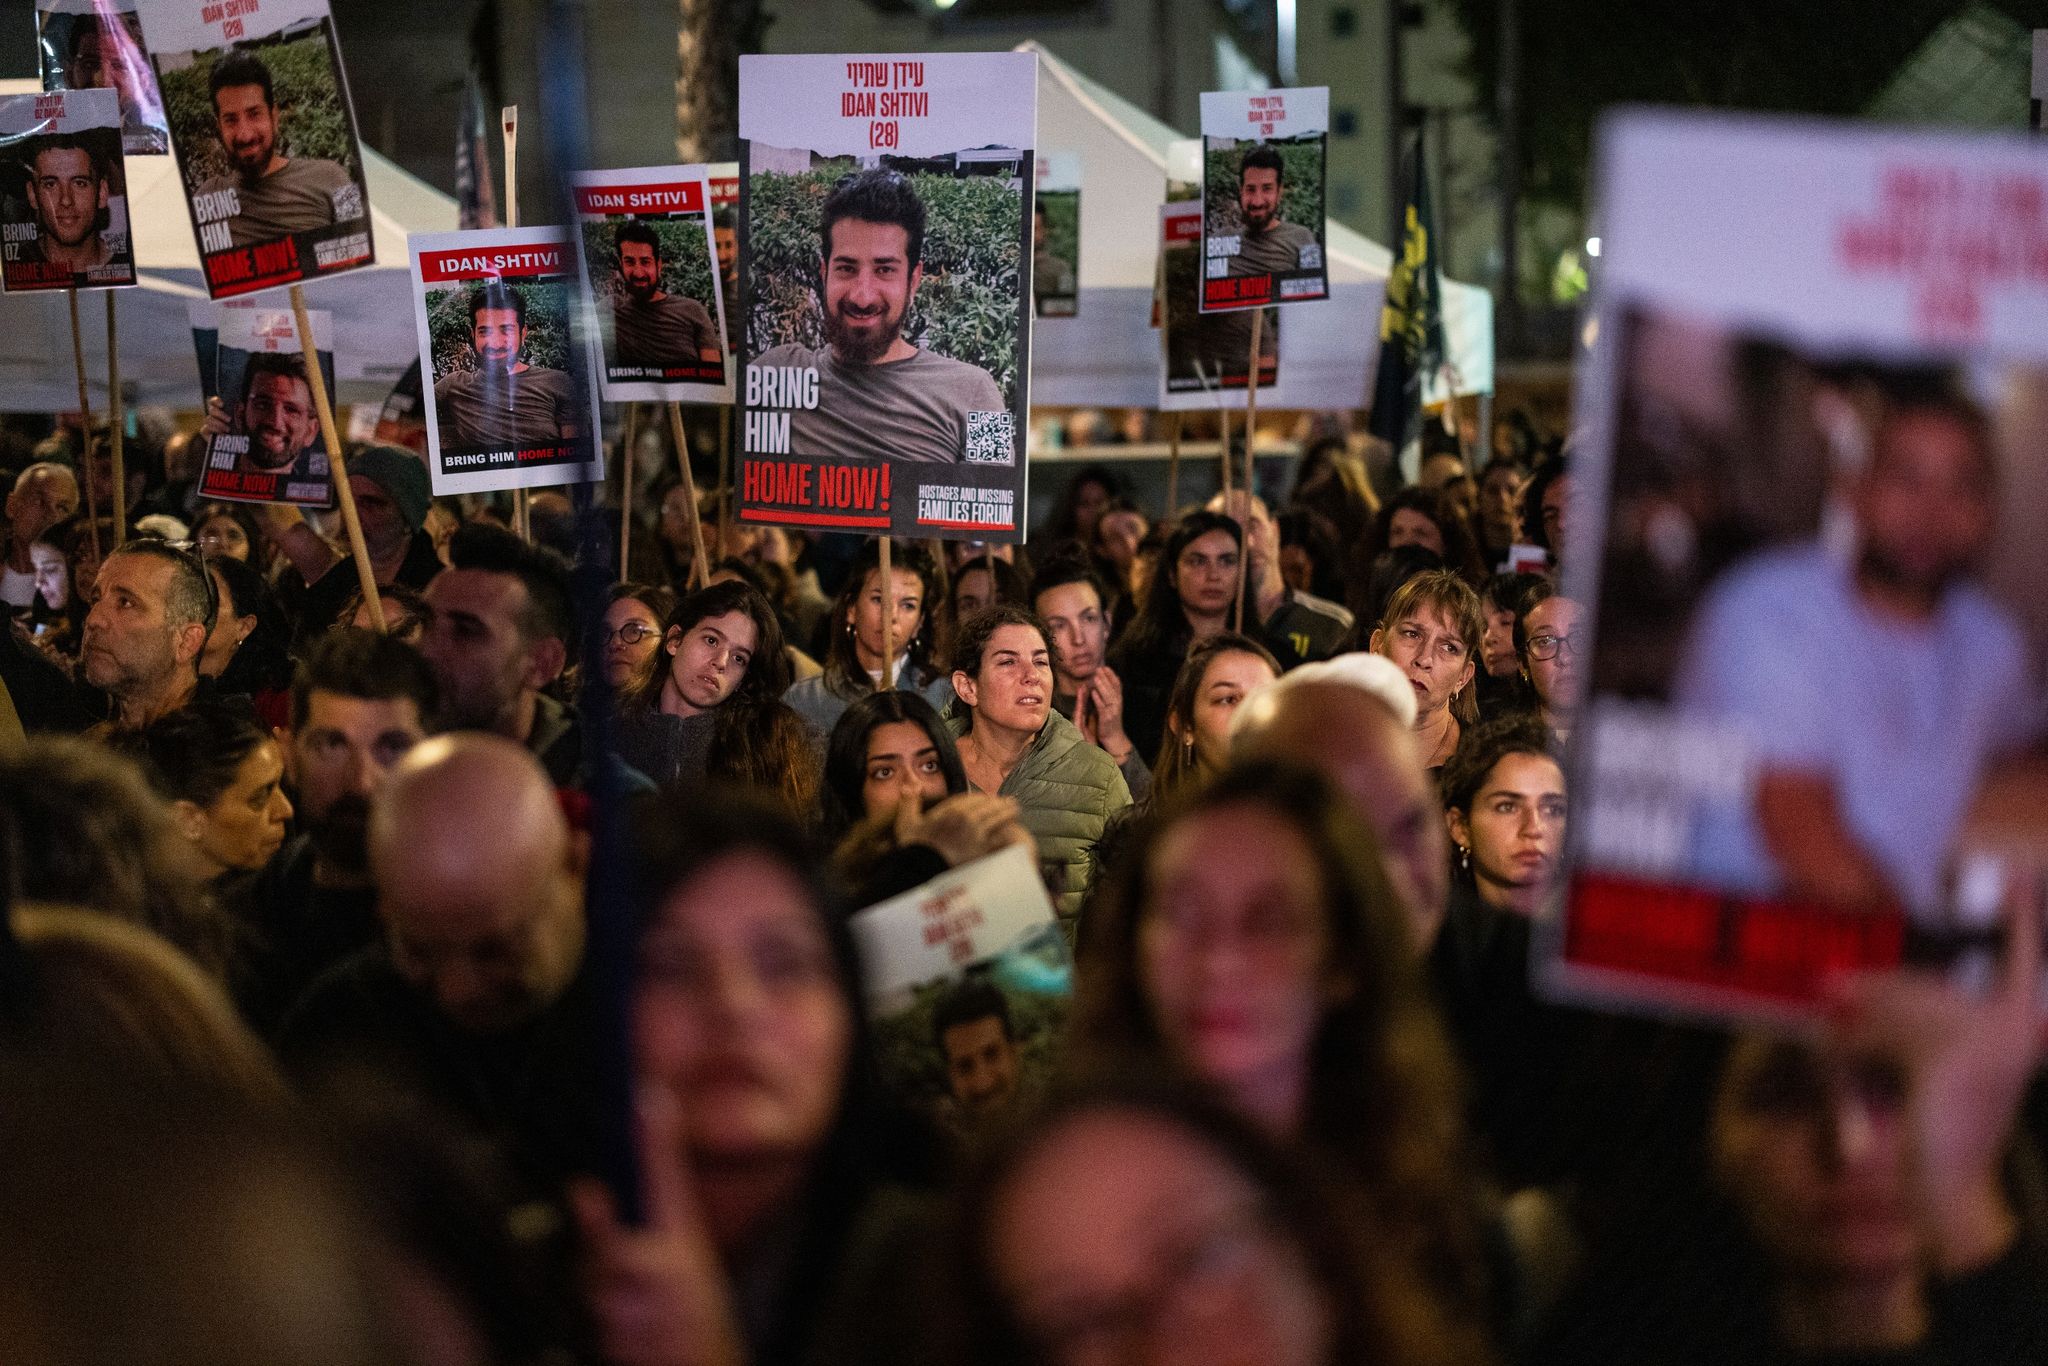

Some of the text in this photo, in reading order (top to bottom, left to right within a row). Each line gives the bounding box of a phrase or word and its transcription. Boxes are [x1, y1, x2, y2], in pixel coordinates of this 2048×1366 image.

[202, 4, 225, 24] IDAN
[223, 18, 244, 40] (28)
[847, 62, 923, 90] עידן שתיוי
[842, 92, 928, 117] IDAN SHTIVI
[870, 120, 899, 149] (28)
[192, 187, 242, 224] BRING
[588, 191, 688, 207] IDAN SHTIVI
[3, 222, 38, 241] BRING
[200, 220, 234, 254] HIM
[5, 243, 20, 260] OZ
[1206, 235, 1241, 257] BRING
[8, 262, 37, 280] HOME
[207, 250, 253, 285] HOME
[253, 235, 299, 276] NOW!
[439, 252, 559, 273] IDAN SHTIVI
[1206, 257, 1229, 278] HIM
[1206, 279, 1237, 299] HOME
[1240, 272, 1272, 296] NOW!
[609, 367, 643, 377] BRING
[645, 367, 663, 377] HIM
[665, 367, 697, 377] HOME
[745, 365, 819, 410] BRING
[745, 411, 791, 455] HIM
[214, 435, 250, 454] BRING
[209, 452, 236, 470] HIM
[445, 453, 485, 466] BRING
[490, 451, 514, 463] HIM
[517, 448, 554, 461] HOME
[207, 470, 241, 488] HOME
[242, 473, 278, 493] NOW!
[744, 461, 890, 511] HOME NOW!
[919, 485, 1014, 504] HOSTAGES AND MISSING
[918, 499, 1014, 525] FAMILIES FORUM
